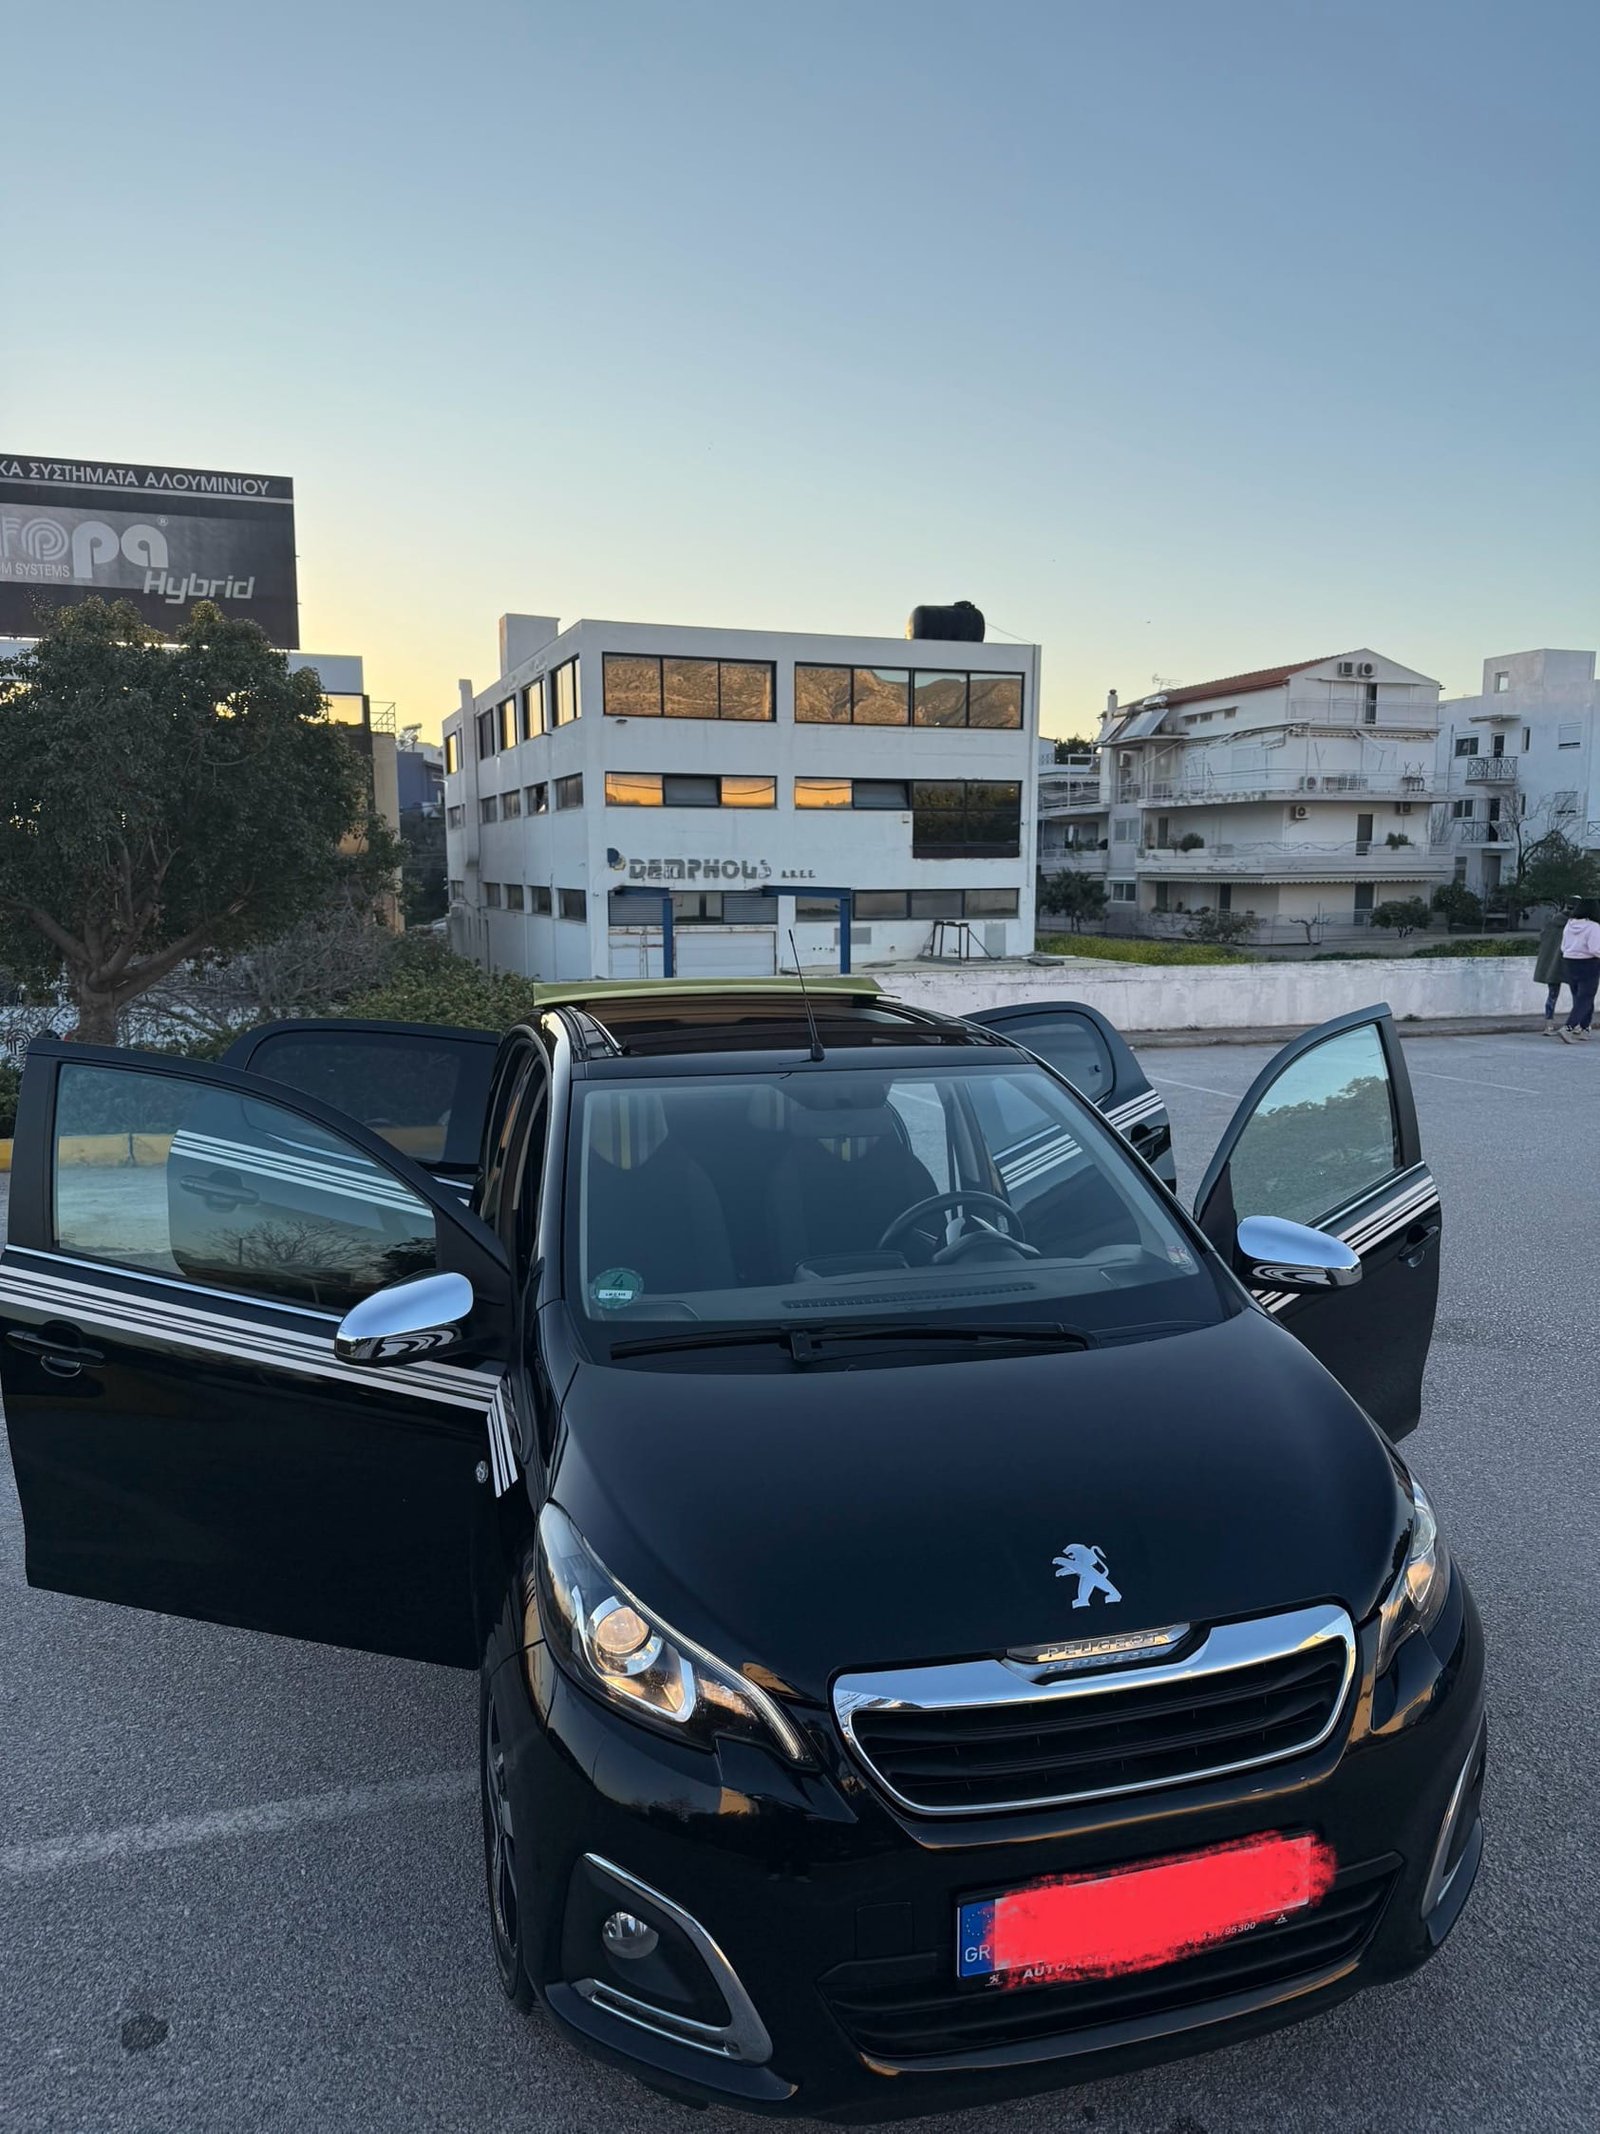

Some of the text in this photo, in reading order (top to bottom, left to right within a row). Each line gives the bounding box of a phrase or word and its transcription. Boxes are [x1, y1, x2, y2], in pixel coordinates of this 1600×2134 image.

[29, 462, 138, 486] ΣΥΣΤΗΜΑΤΑ
[145, 472, 269, 496] ΑΛΟΥΜΙΝΙΟΥ
[15, 562, 70, 578] SYSTEMS
[143, 571, 256, 604] Hybrid
[611, 1273, 625, 1288] 4
[1047, 1632, 1159, 1658] PEUGEOT
[964, 1944, 991, 1963] GR
